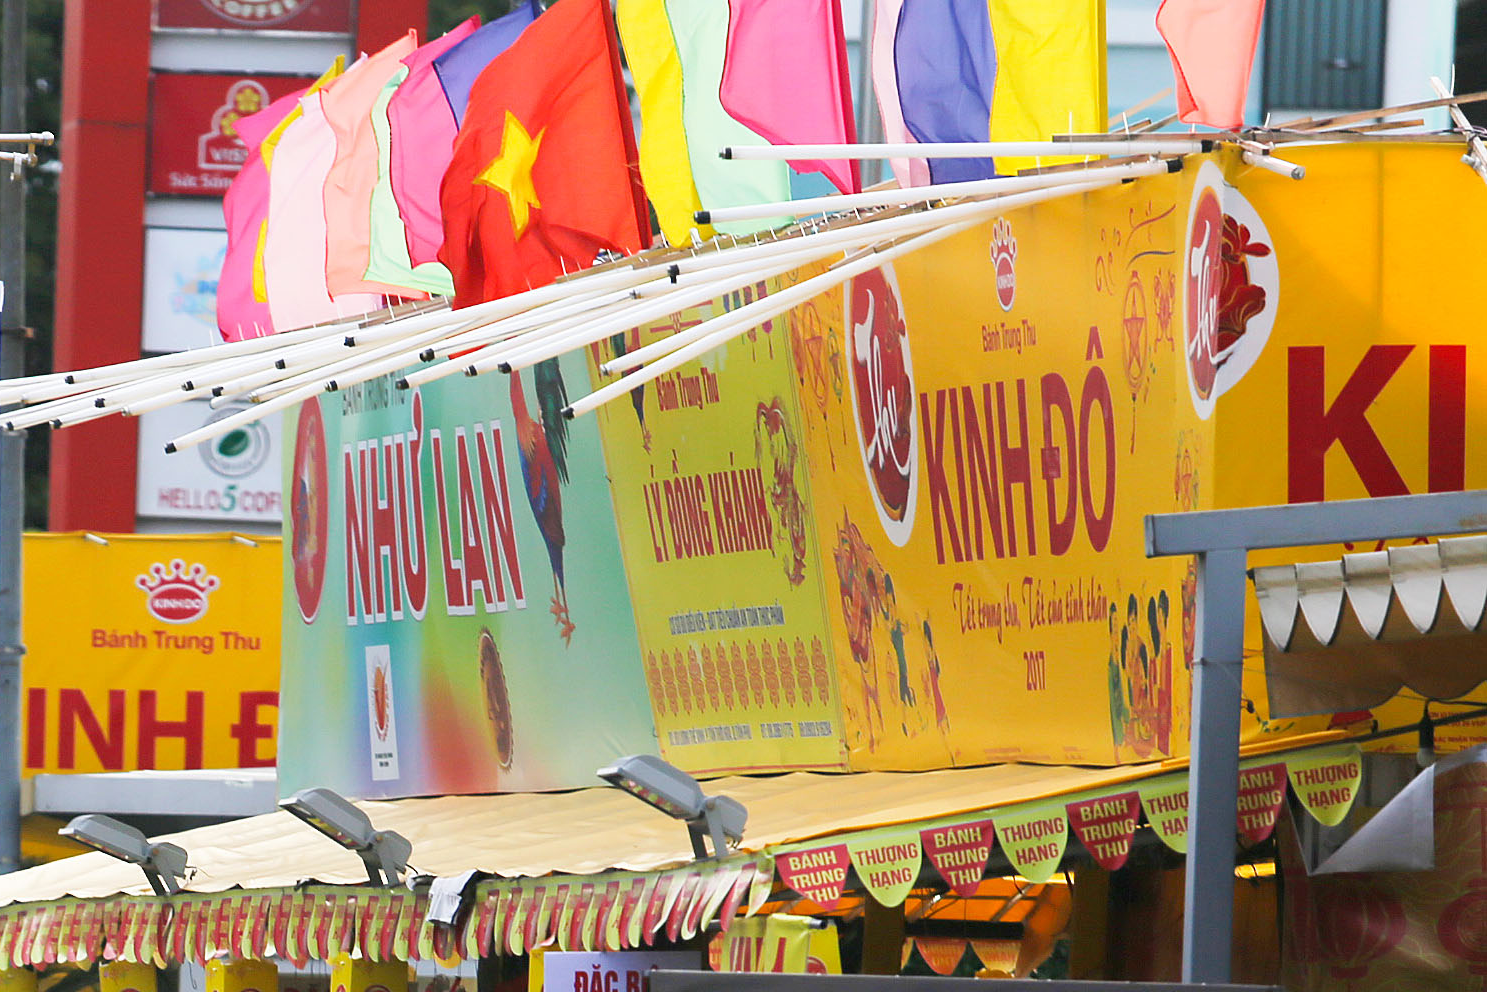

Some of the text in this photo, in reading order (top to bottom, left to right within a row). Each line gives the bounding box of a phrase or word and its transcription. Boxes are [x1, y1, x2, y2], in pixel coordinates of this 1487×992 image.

[1022, 319, 1037, 346] Thu
[919, 325, 1115, 564] KINH ĐÔ
[344, 388, 527, 626] NHƯ LAN
[643, 449, 773, 563] LÝ ĐỒNG KHÁNH
[92, 629, 262, 655] Bánh Trung Thu
[1023, 651, 1046, 691] 2017
[1294, 762, 1359, 786] THƯỢNG
[1080, 799, 1129, 822] BÁNH
[1148, 791, 1189, 815] THƯỢ
[1237, 790, 1282, 812] RUNG
[1307, 787, 1352, 810] HẠNG
[1001, 817, 1064, 843] THƯỢNG
[1081, 818, 1135, 842] TRUNG
[1240, 811, 1275, 831] THU
[933, 821, 982, 848] BÁNH
[788, 850, 838, 871] BÁNH
[857, 843, 919, 867] THƯỢNG
[934, 846, 989, 868] TRUNG
[1016, 843, 1059, 867] HẠNG
[1094, 839, 1129, 860] THU
[790, 867, 846, 889] TRUNG
[869, 867, 913, 890] HẠNG
[948, 866, 983, 886] THU
[806, 886, 841, 903] THU
